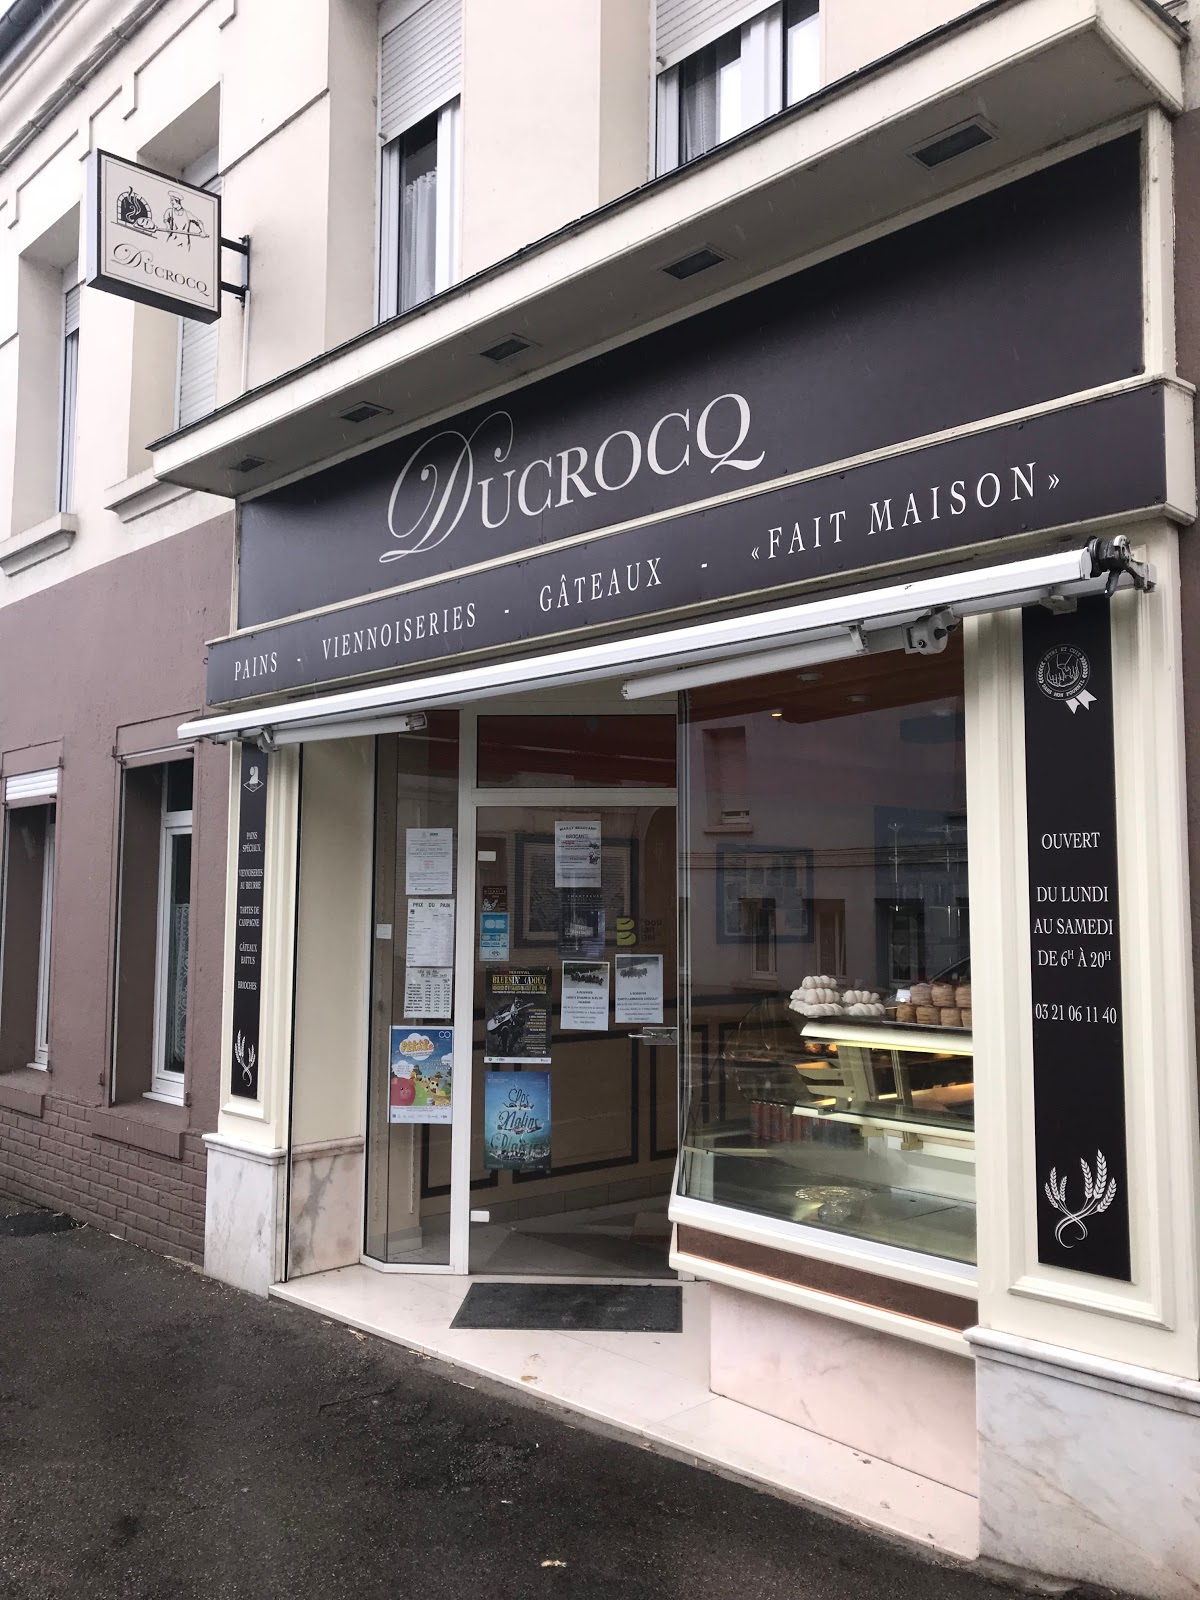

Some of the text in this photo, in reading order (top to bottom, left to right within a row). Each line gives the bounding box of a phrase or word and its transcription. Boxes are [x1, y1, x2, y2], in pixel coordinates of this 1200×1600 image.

[234, 651, 278, 681] PAINS
[322, 602, 477, 661] VIENNOISERIES
[539, 557, 662, 613] GÂTEAUX
[246, 831, 258, 840] PAINS
[1041, 832, 1101, 849] OUVERT
[242, 843, 261, 852] SPÉCIAUX
[239, 868, 263, 877] VIENNOISERIES
[240, 881, 261, 889] AU BEURRE
[1036, 886, 1109, 903] DU LUNDI
[240, 905, 260, 914] TARTES DE
[238, 918, 260, 927] CAMPAGNE
[1033, 918, 1113, 935] AU SAMEDI
[239, 942, 257, 952] GÂTEAUX
[241, 955, 255, 965] BATTUS
[1038, 949, 1058, 966] DE
[1077, 946, 1088, 967] À
[237, 980, 257, 990] BRIOCHES
[1035, 1003, 1117, 1024] 03 21 06 11 40
